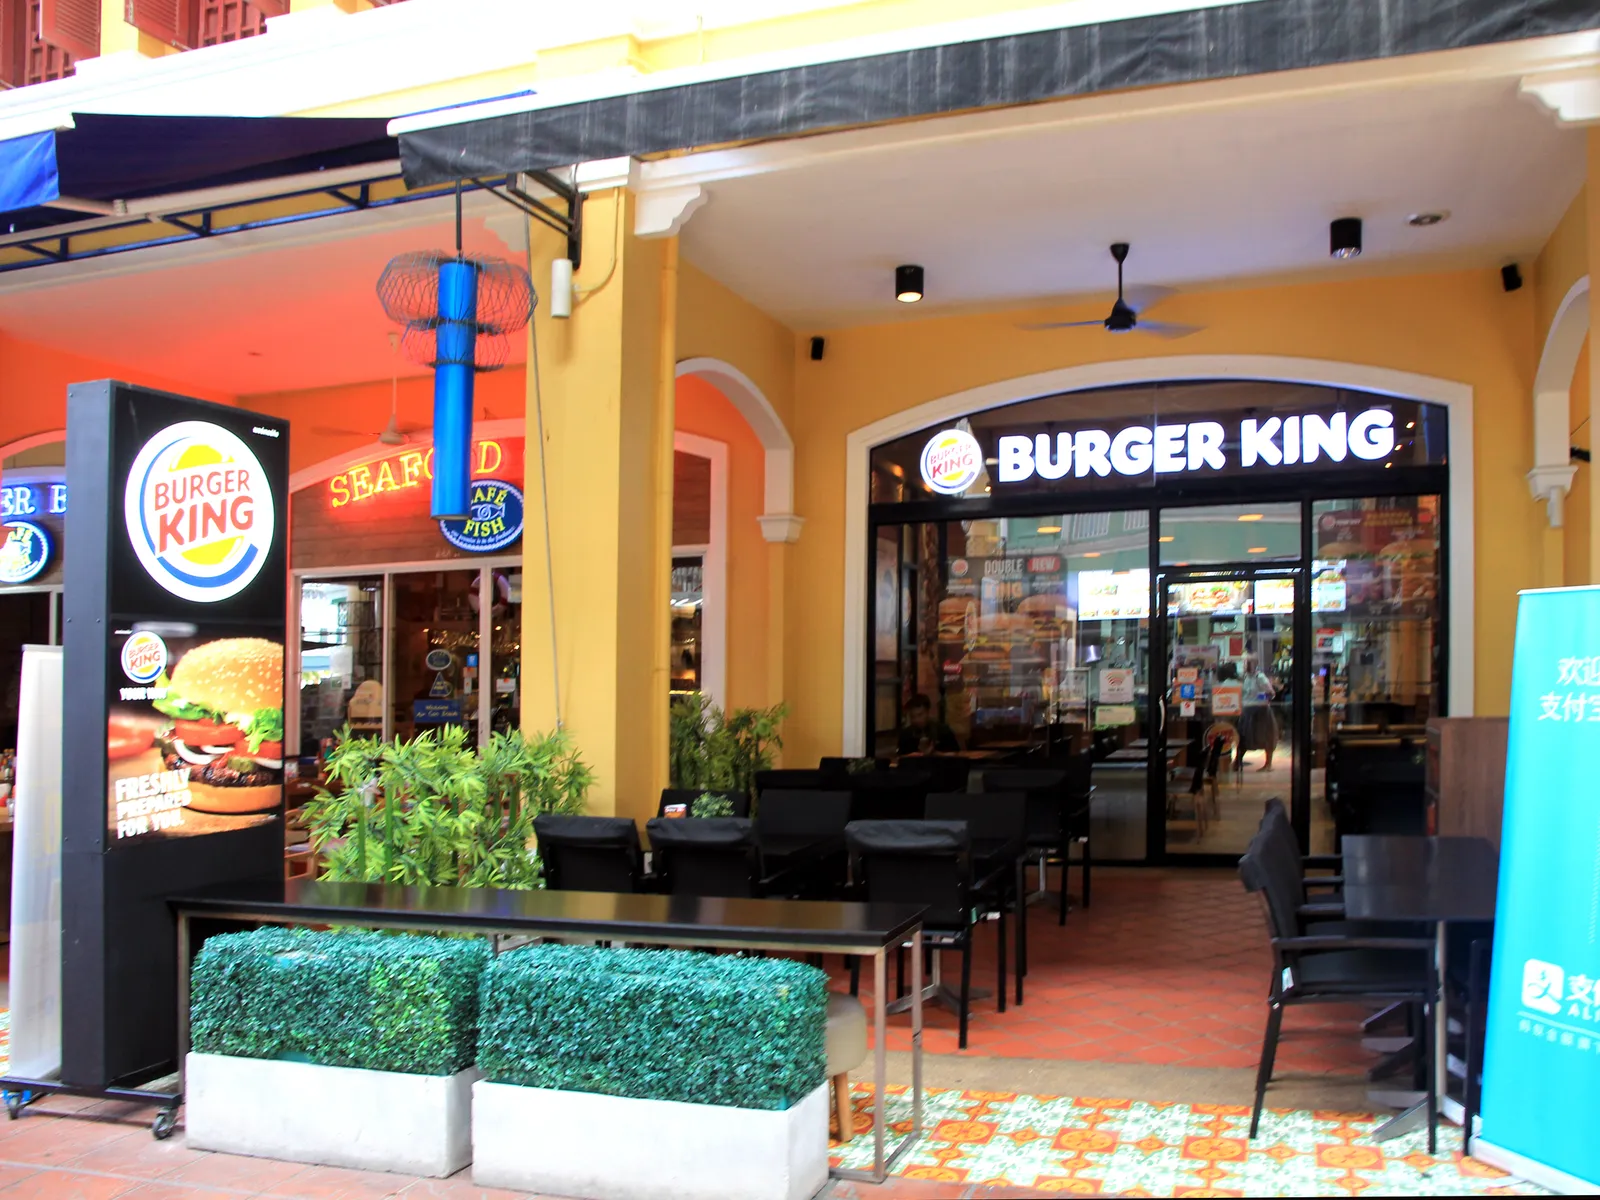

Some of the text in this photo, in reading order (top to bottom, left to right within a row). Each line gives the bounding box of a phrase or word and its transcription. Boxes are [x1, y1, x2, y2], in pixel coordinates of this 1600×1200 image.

[999, 408, 1395, 483] BURGER KING
[330, 441, 502, 508] SEAFD
[931, 453, 973, 479] KING
[154, 469, 250, 512] BURGER
[158, 495, 254, 553] KING
[463, 516, 506, 537] FISH
[984, 558, 1024, 576] DOUBLE
[128, 642, 159, 659] BURGER
[129, 651, 161, 671] KING
[115, 768, 191, 801] FRESHLY
[116, 789, 193, 820] PREPARED
[117, 816, 150, 840] FOR
